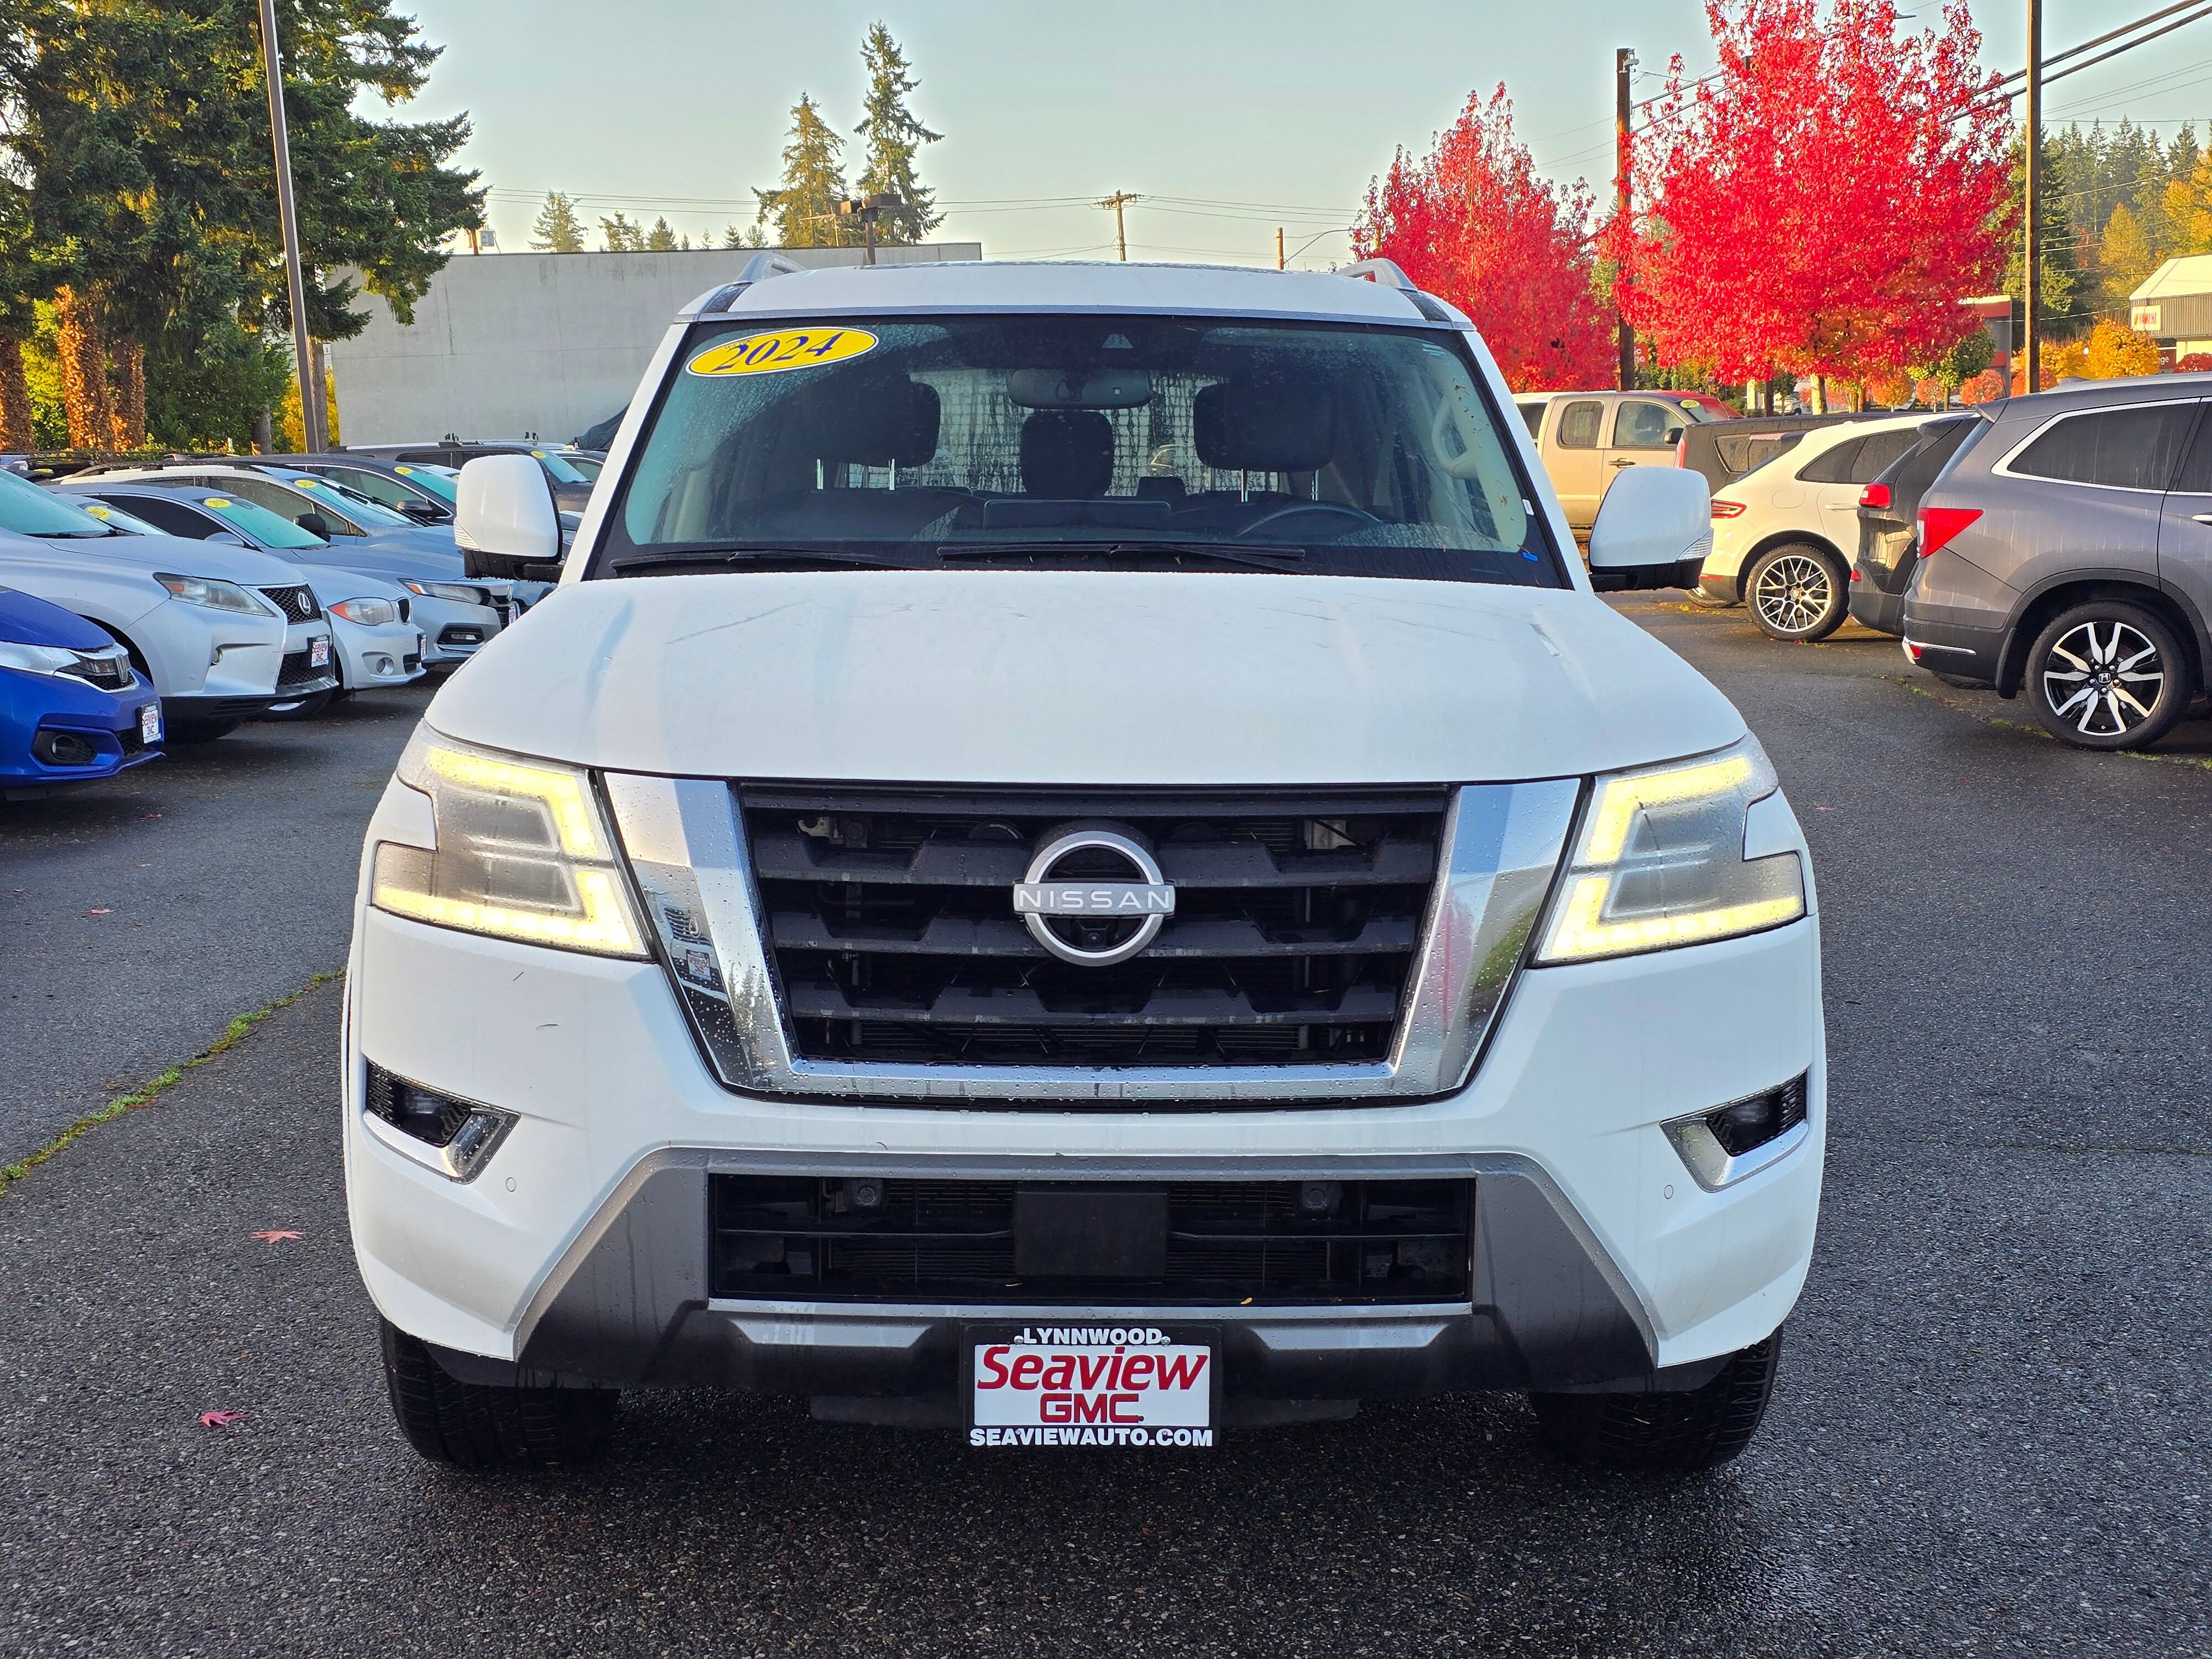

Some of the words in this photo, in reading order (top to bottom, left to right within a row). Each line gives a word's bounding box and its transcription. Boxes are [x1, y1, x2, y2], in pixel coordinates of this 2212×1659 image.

[709, 332, 846, 372] 2024
[1019, 890, 1169, 908] NISSAN
[1023, 1328, 1162, 1344] LYNNWOOD
[977, 1347, 1208, 1390] Seaview
[1040, 1394, 1140, 1423] GMC
[969, 1428, 1212, 1447] SEAVIEWAUTO.COM
